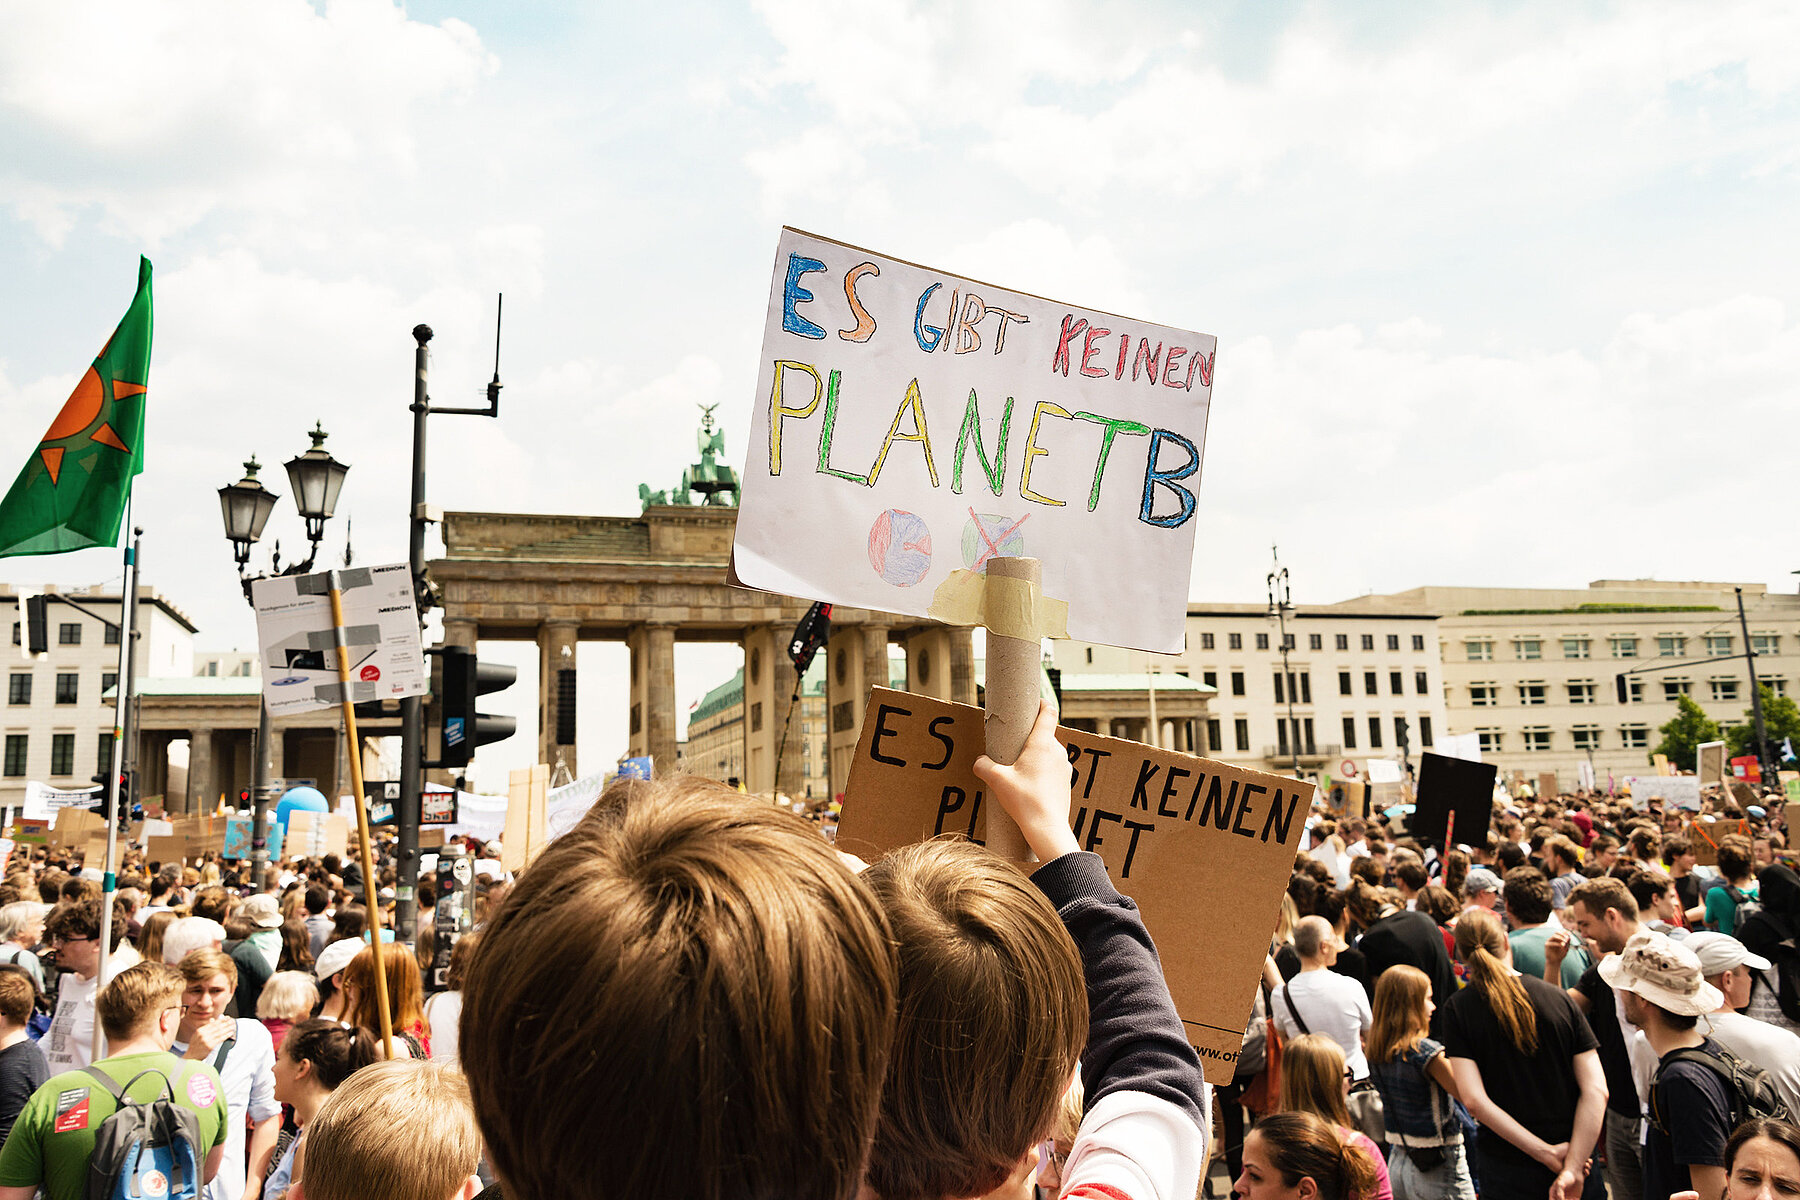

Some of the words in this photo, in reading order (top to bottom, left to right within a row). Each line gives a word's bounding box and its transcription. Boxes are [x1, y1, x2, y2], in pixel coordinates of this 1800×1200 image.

[782, 251, 880, 343] ES
[914, 281, 1030, 355] GIBT
[1052, 313, 1214, 392] KEINEN
[372, 565, 406, 574] MEDION
[379, 604, 411, 614] MEDION
[870, 703, 955, 771] ES
[1131, 759, 1299, 845] KEINEN
